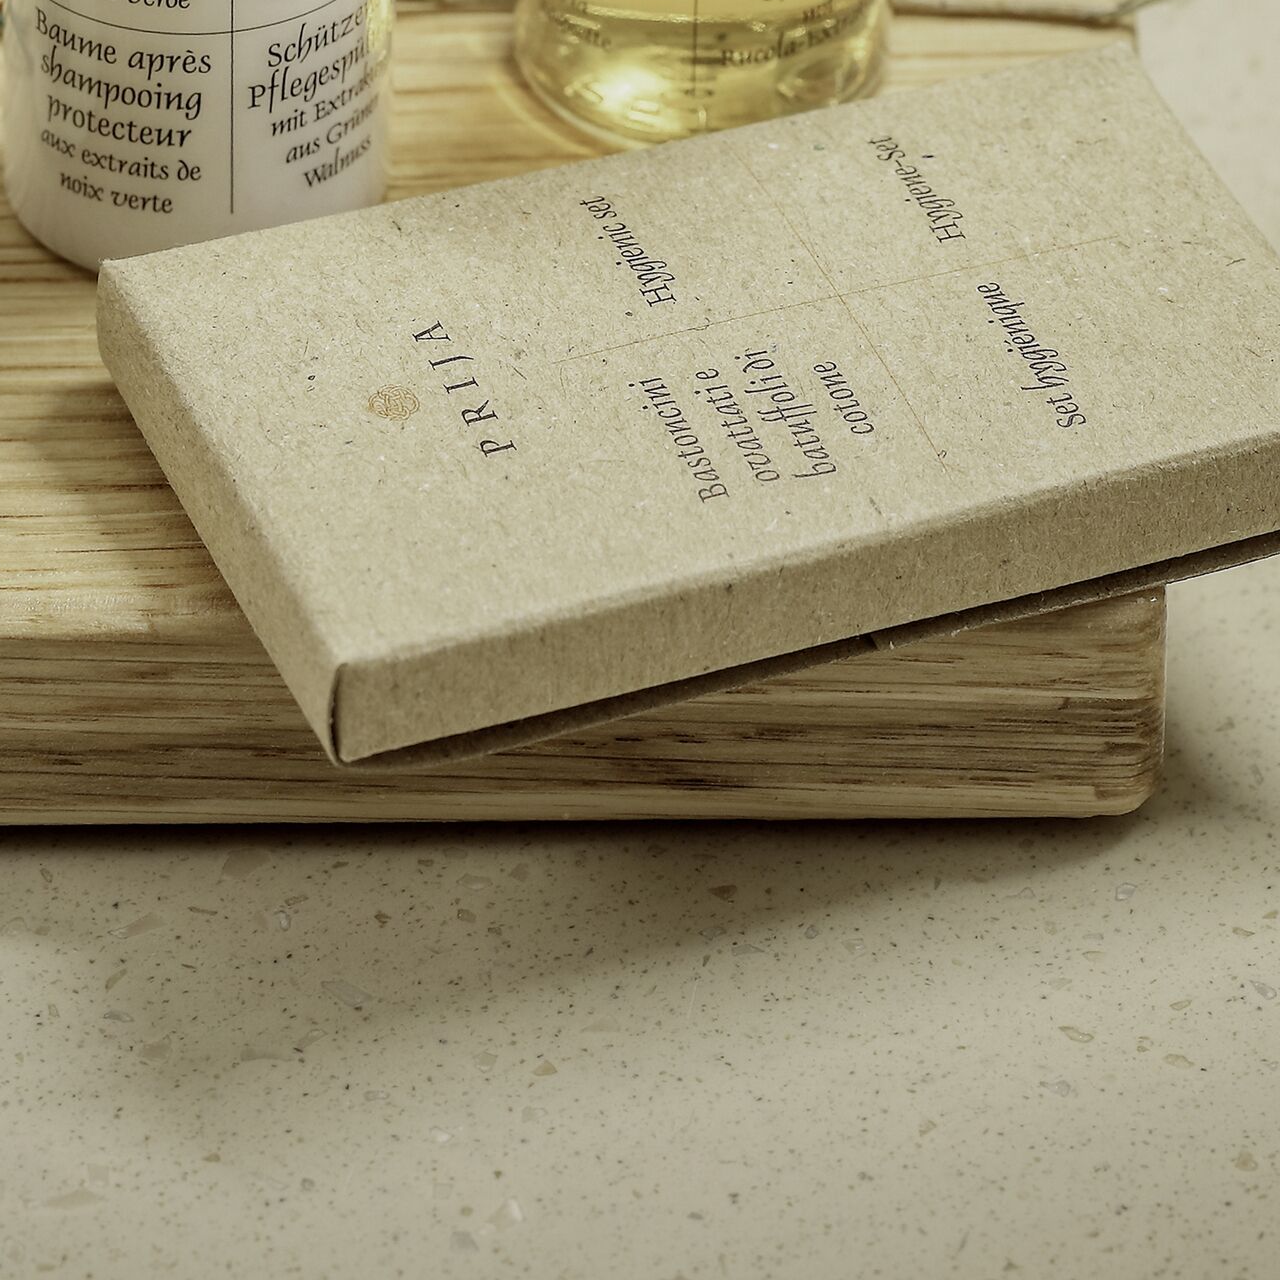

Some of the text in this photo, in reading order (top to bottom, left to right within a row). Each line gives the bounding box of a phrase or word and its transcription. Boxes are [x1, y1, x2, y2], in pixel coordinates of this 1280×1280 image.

[35, 7, 212, 80] Baume après
[41, 45, 202, 120] shampooing
[41, 129, 202, 181] aux extraits de
[47, 95, 192, 147] protecteur
[272, 109, 307, 137] mit
[286, 137, 320, 164] aus
[60, 175, 174, 214] noix verte
[580, 196, 676, 307] Hygienic set
[977, 282, 1069, 391] hygiénique
[412, 320, 517, 457] PRIJA
[694, 368, 780, 482] ovattati e
[734, 350, 837, 479] batuffoli di
[813, 361, 875, 435] cotone
[628, 377, 730, 503] Bastoncini
